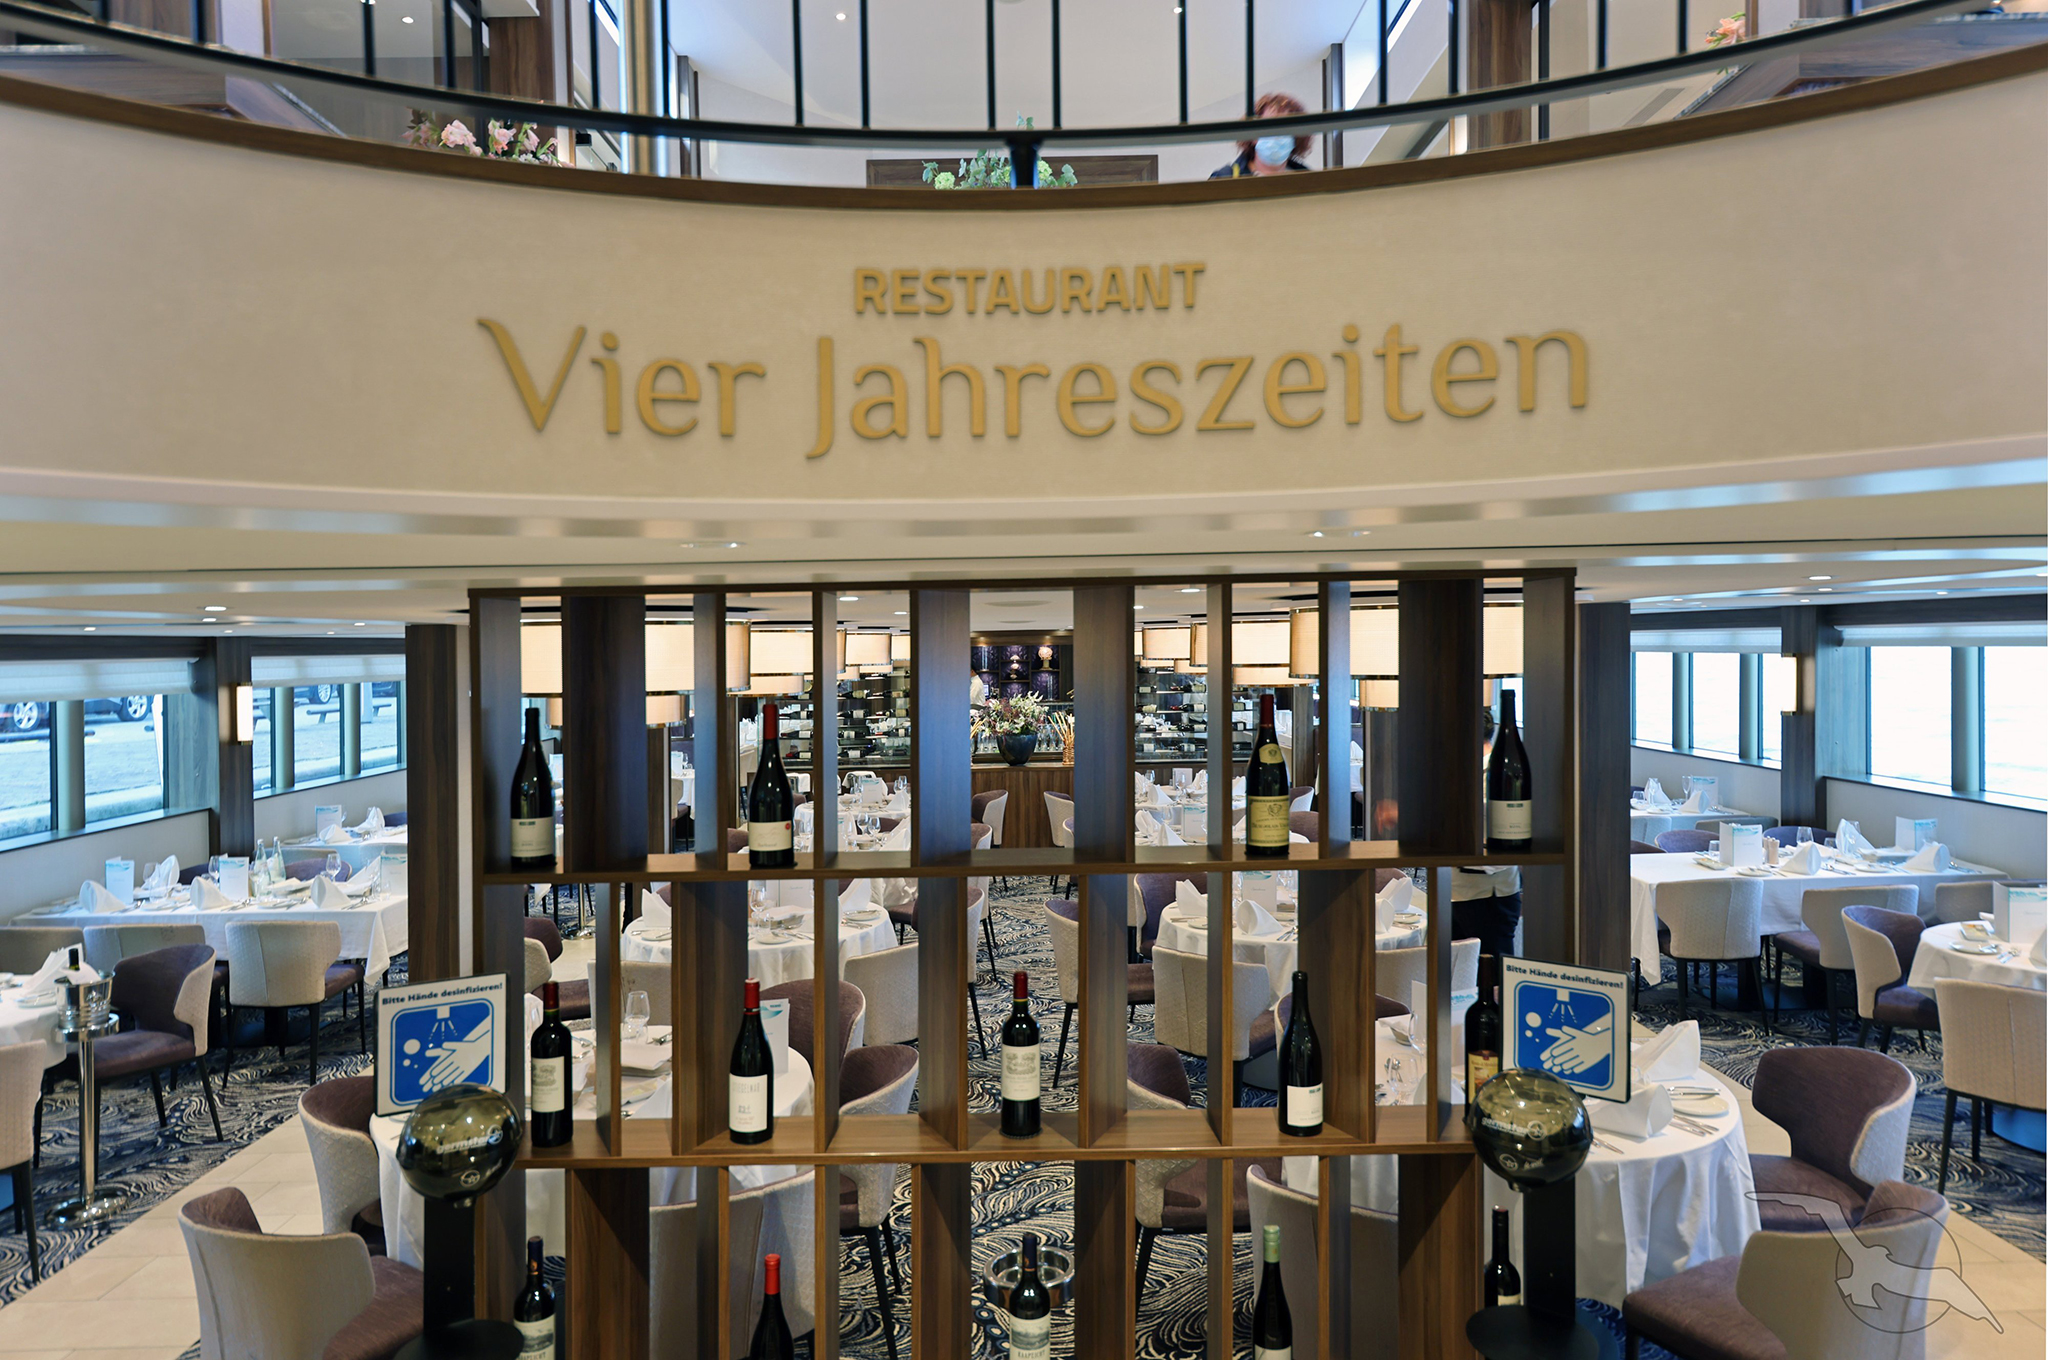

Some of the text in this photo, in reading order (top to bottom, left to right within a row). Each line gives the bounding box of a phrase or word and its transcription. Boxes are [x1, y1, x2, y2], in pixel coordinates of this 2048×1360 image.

[855, 263, 1206, 315] RESTAURANT
[476, 318, 1590, 460] Vier Jahreszeiten
[381, 982, 503, 1005] Bitte Hände desinfizieren!
[1506, 964, 1624, 989] Bitte Hände desinfizieren!
